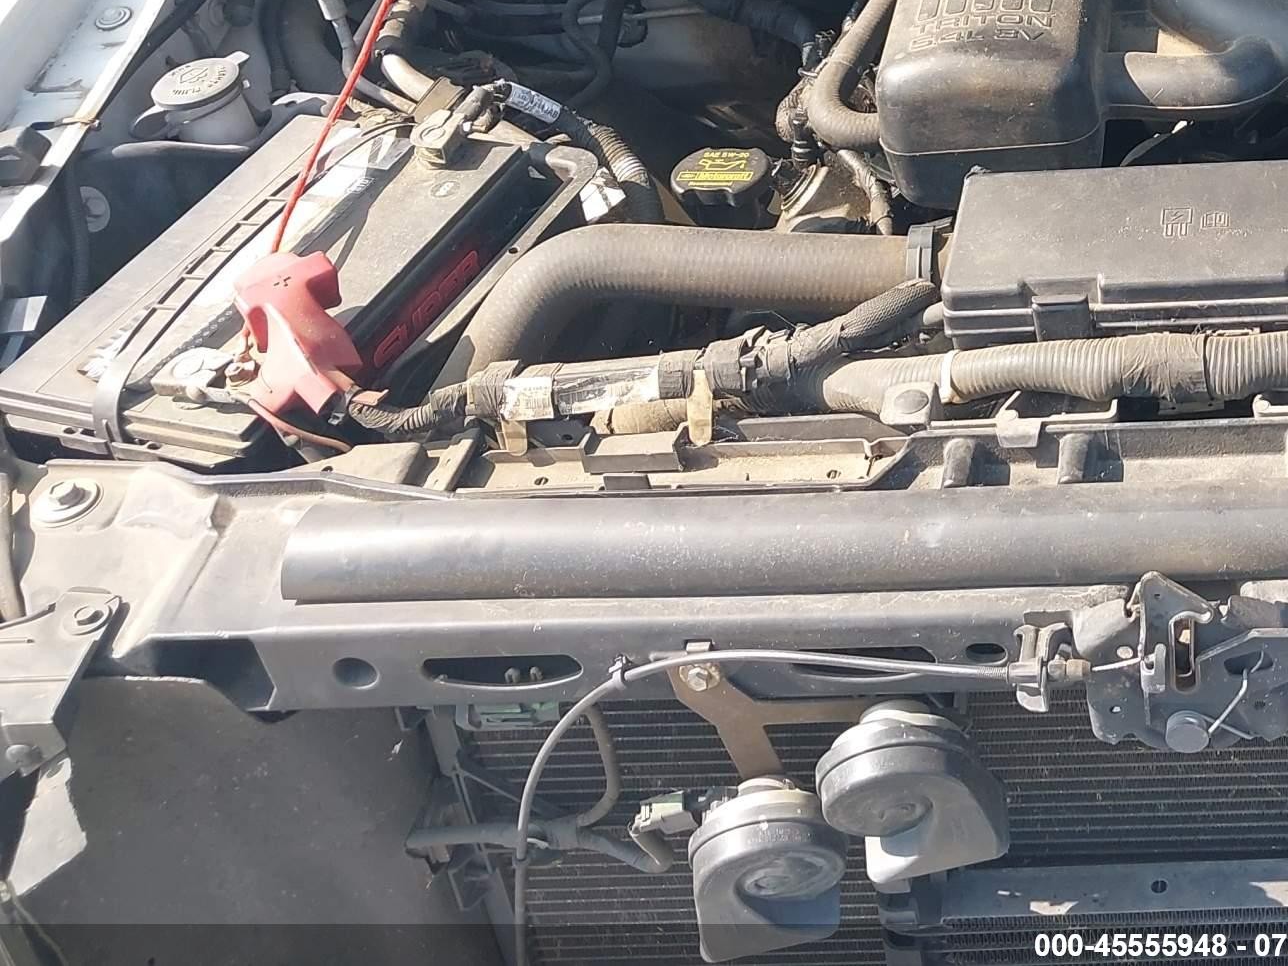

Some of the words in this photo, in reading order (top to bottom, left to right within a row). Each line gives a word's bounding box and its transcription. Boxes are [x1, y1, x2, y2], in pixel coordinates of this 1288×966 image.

[911, 13, 1057, 34] TRITON
[909, 29, 985, 52] 5.4L
[993, 27, 1045, 41] 3V
